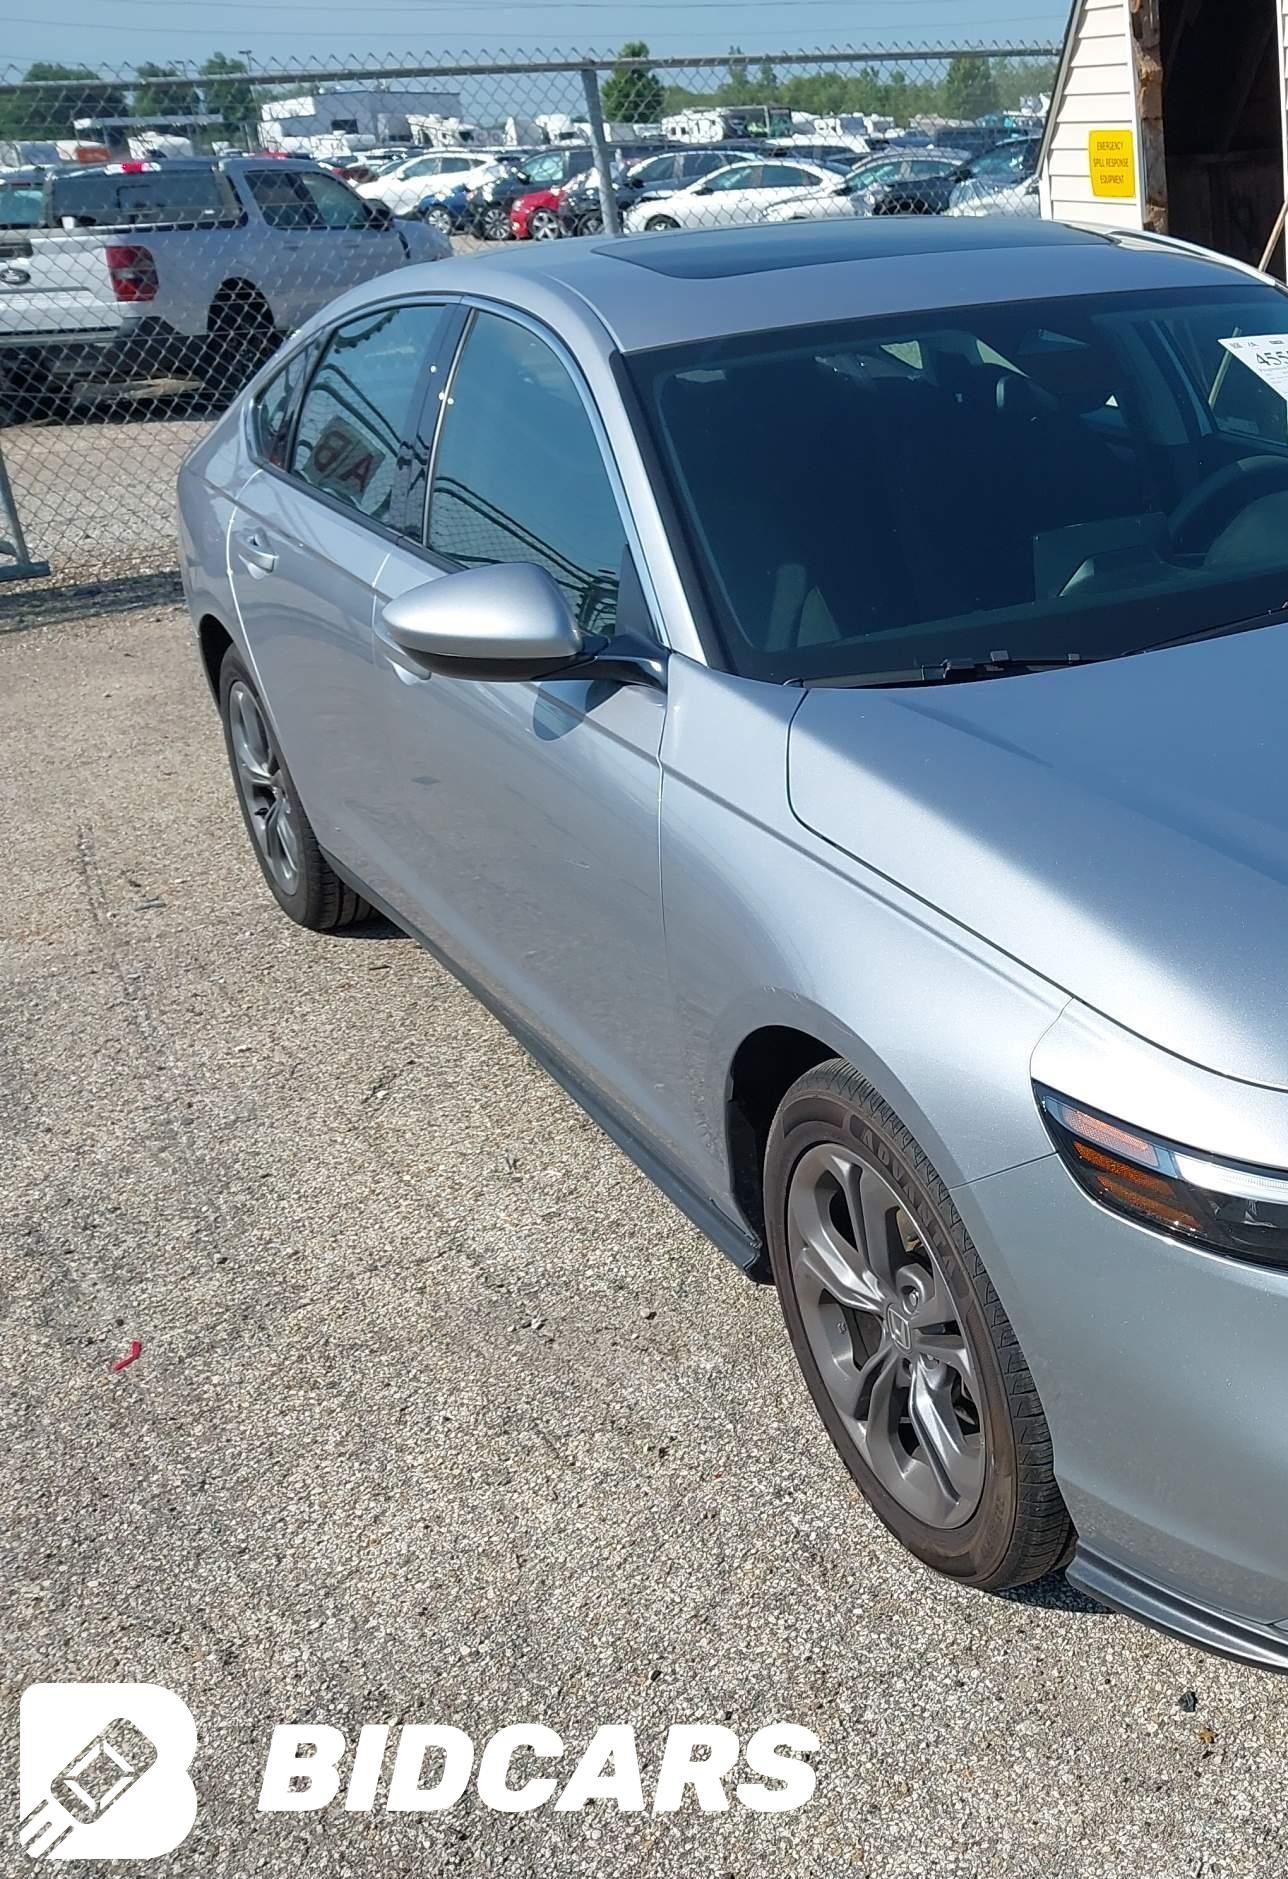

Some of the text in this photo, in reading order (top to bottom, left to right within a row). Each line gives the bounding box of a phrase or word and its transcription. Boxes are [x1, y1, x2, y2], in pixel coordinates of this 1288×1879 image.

[1096, 141, 1124, 151] EMERGENCY
[1093, 158, 1129, 168] SPILL RESPONSE
[1100, 174, 1124, 184] EQUIPMENT
